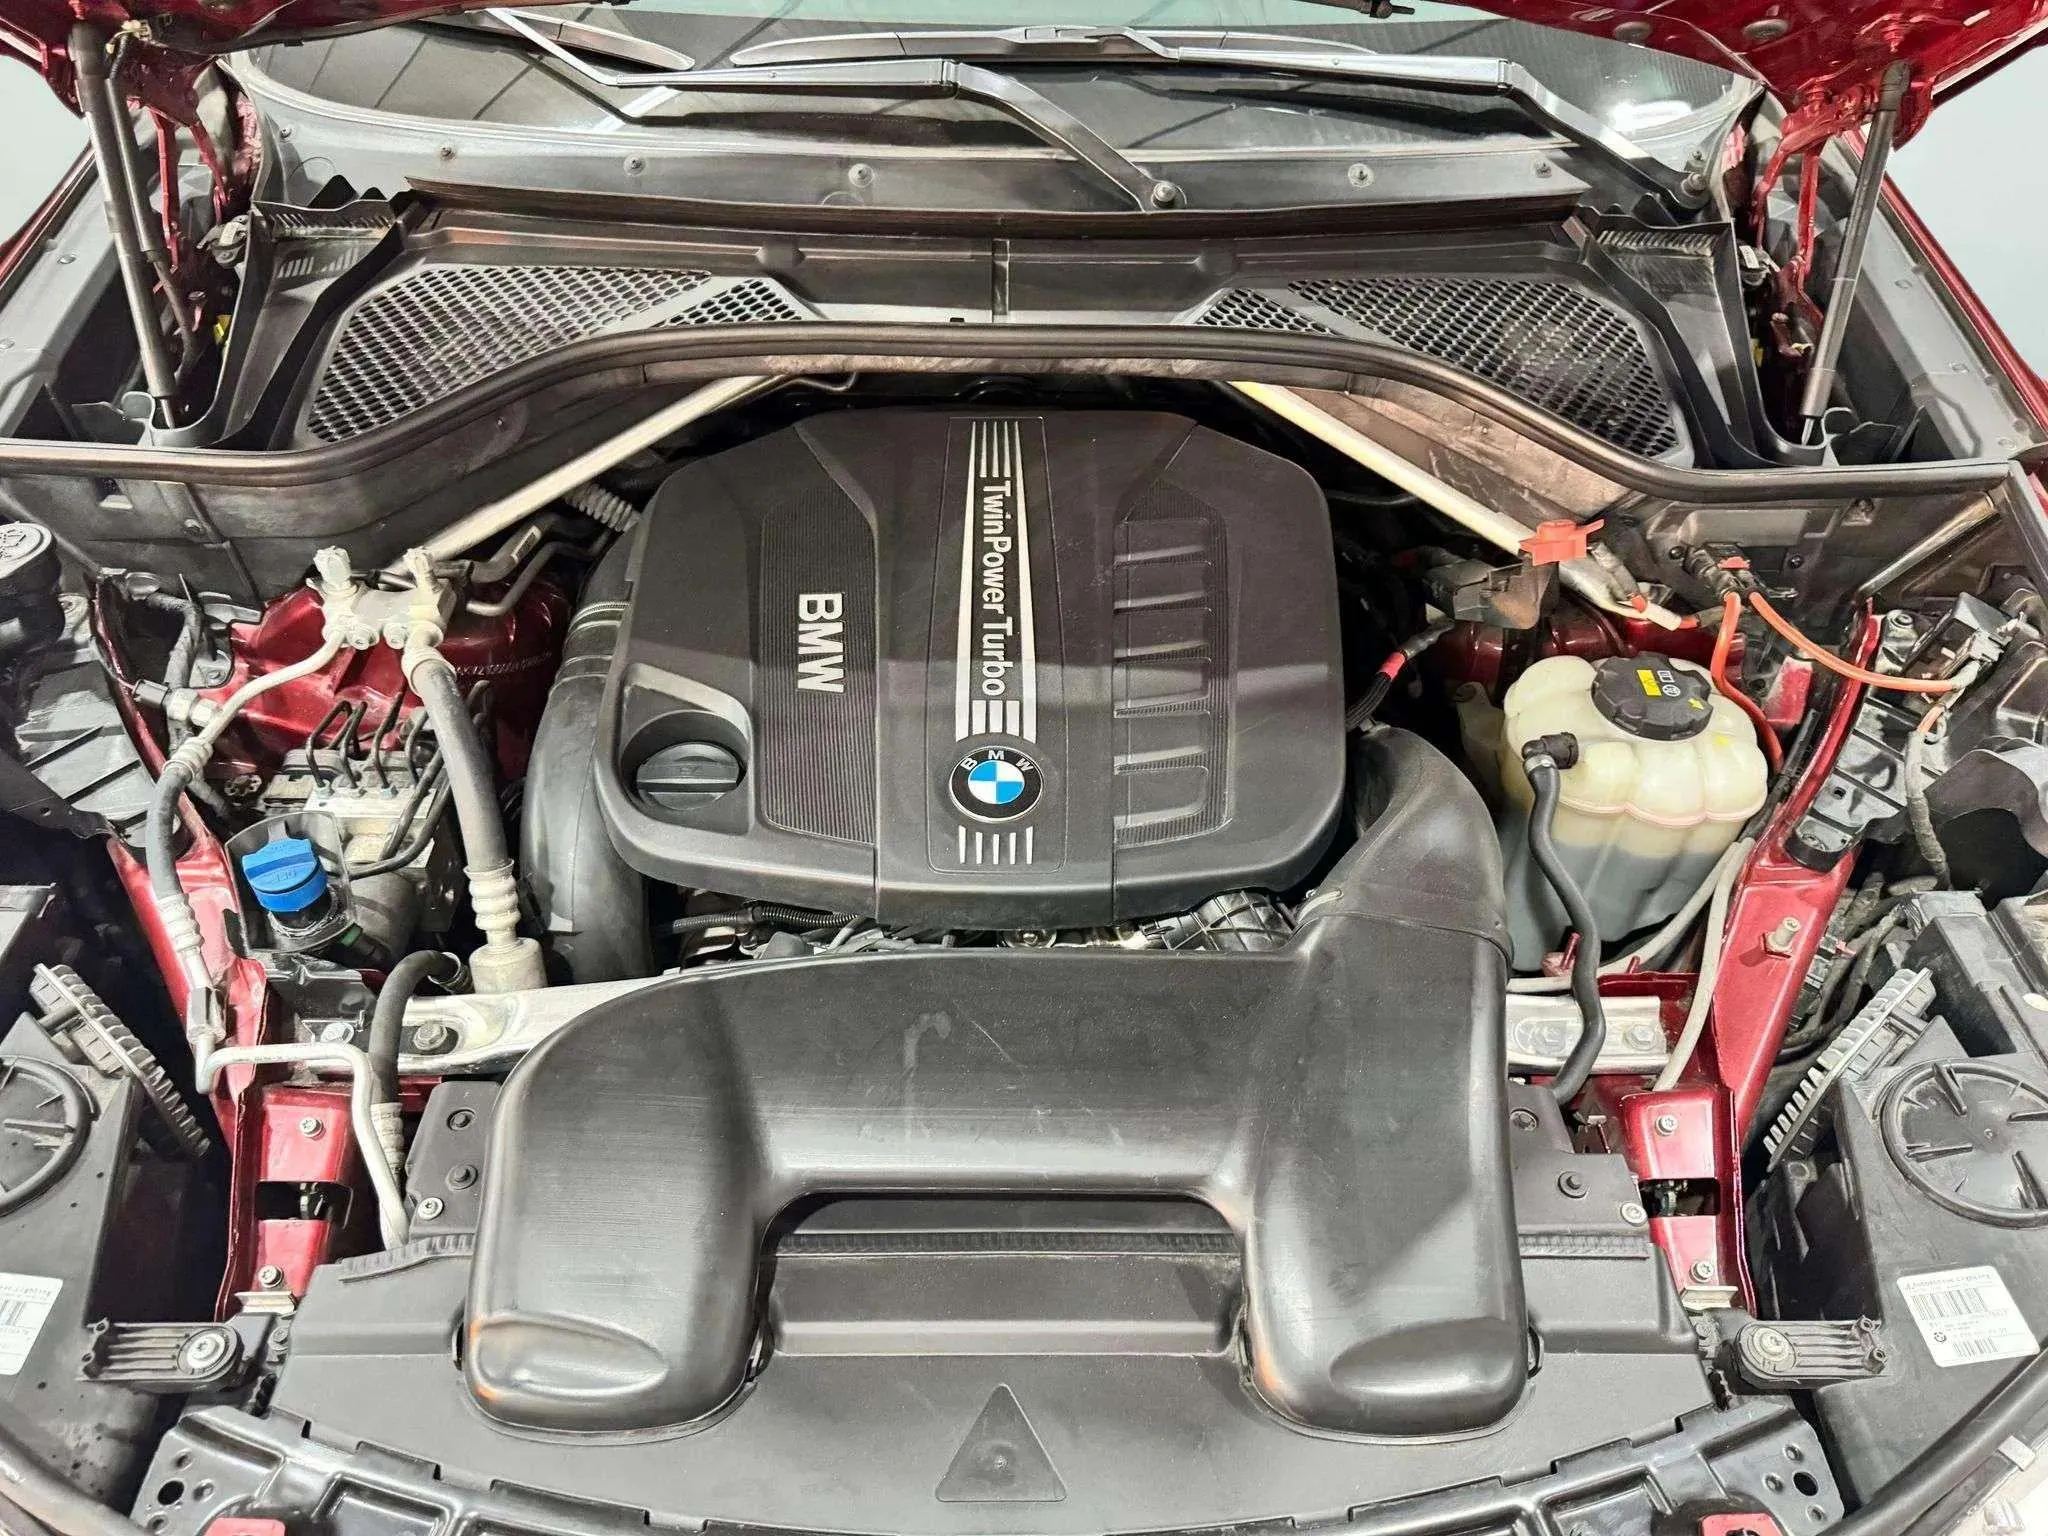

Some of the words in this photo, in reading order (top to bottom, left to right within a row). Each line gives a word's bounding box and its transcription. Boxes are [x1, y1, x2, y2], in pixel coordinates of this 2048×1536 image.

[983, 480, 1012, 614] TwinPower
[798, 593, 844, 692] BMW
[982, 616, 1013, 696] Turbo
[960, 750, 1034, 771] BMW
